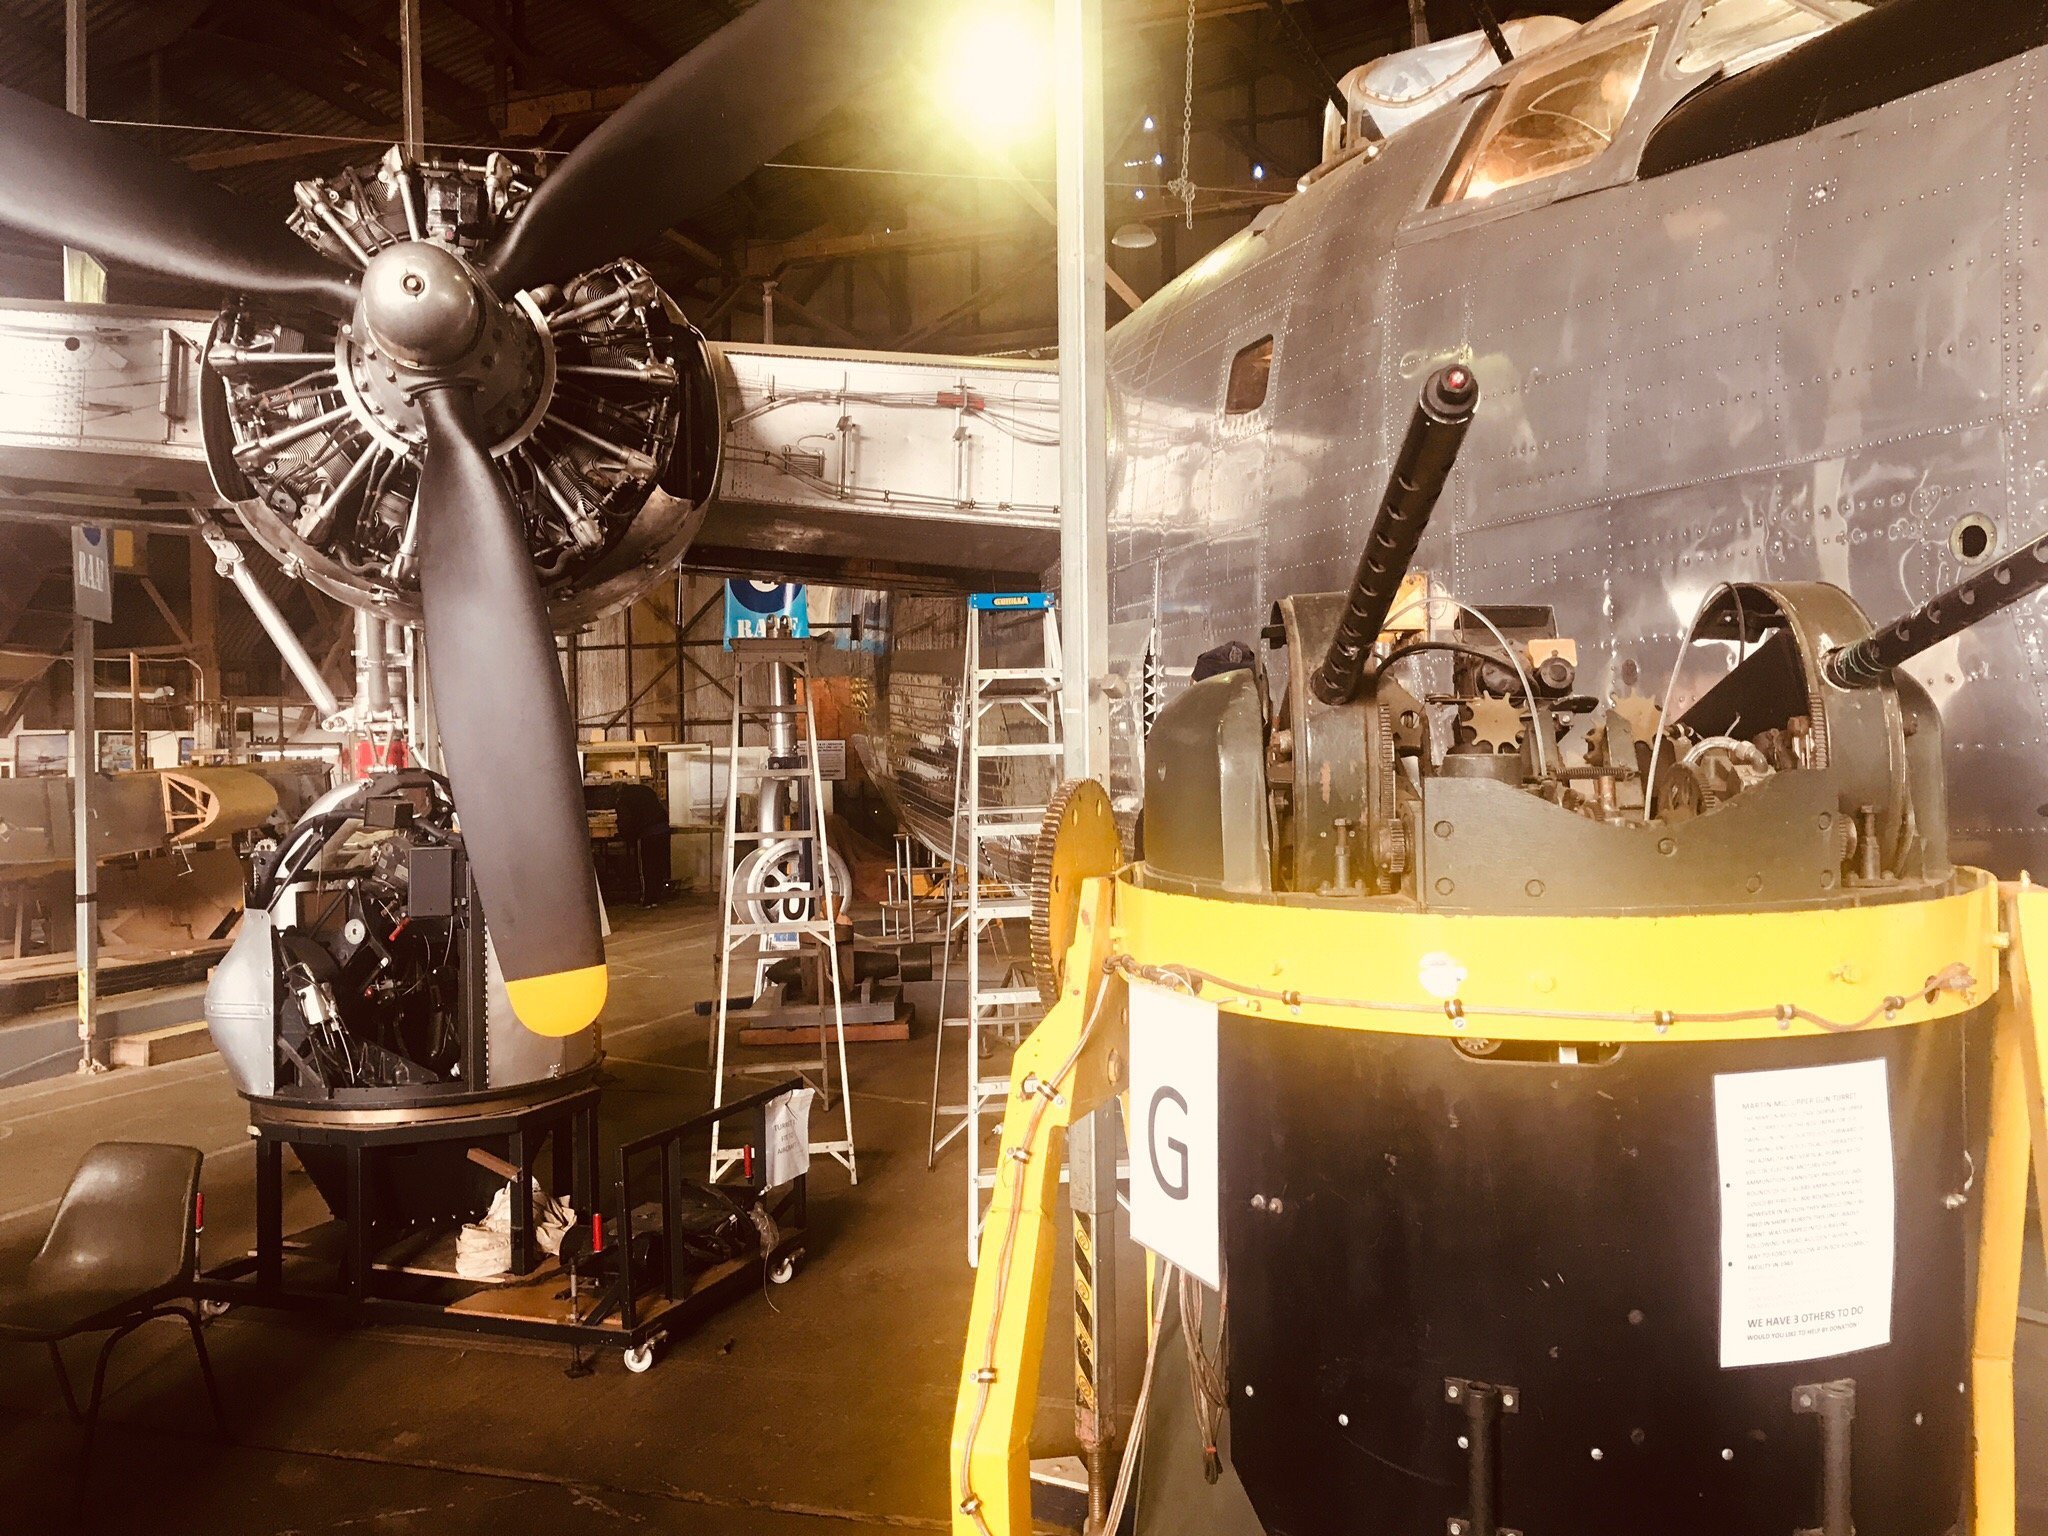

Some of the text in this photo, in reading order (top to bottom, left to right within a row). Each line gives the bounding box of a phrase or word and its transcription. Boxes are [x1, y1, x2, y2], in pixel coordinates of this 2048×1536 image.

[737, 617, 798, 638] RAF
[1147, 1085, 1189, 1201] G
[1747, 1305, 1864, 1329] WE HAVE 3 OTHERS TO DO
[1747, 1333, 1770, 1342] WOULD
[1772, 1331, 1784, 1339] YOU
[1799, 1328, 1805, 1336] TO
[1807, 1326, 1820, 1334] HELP
[1821, 1325, 1829, 1333] BY
